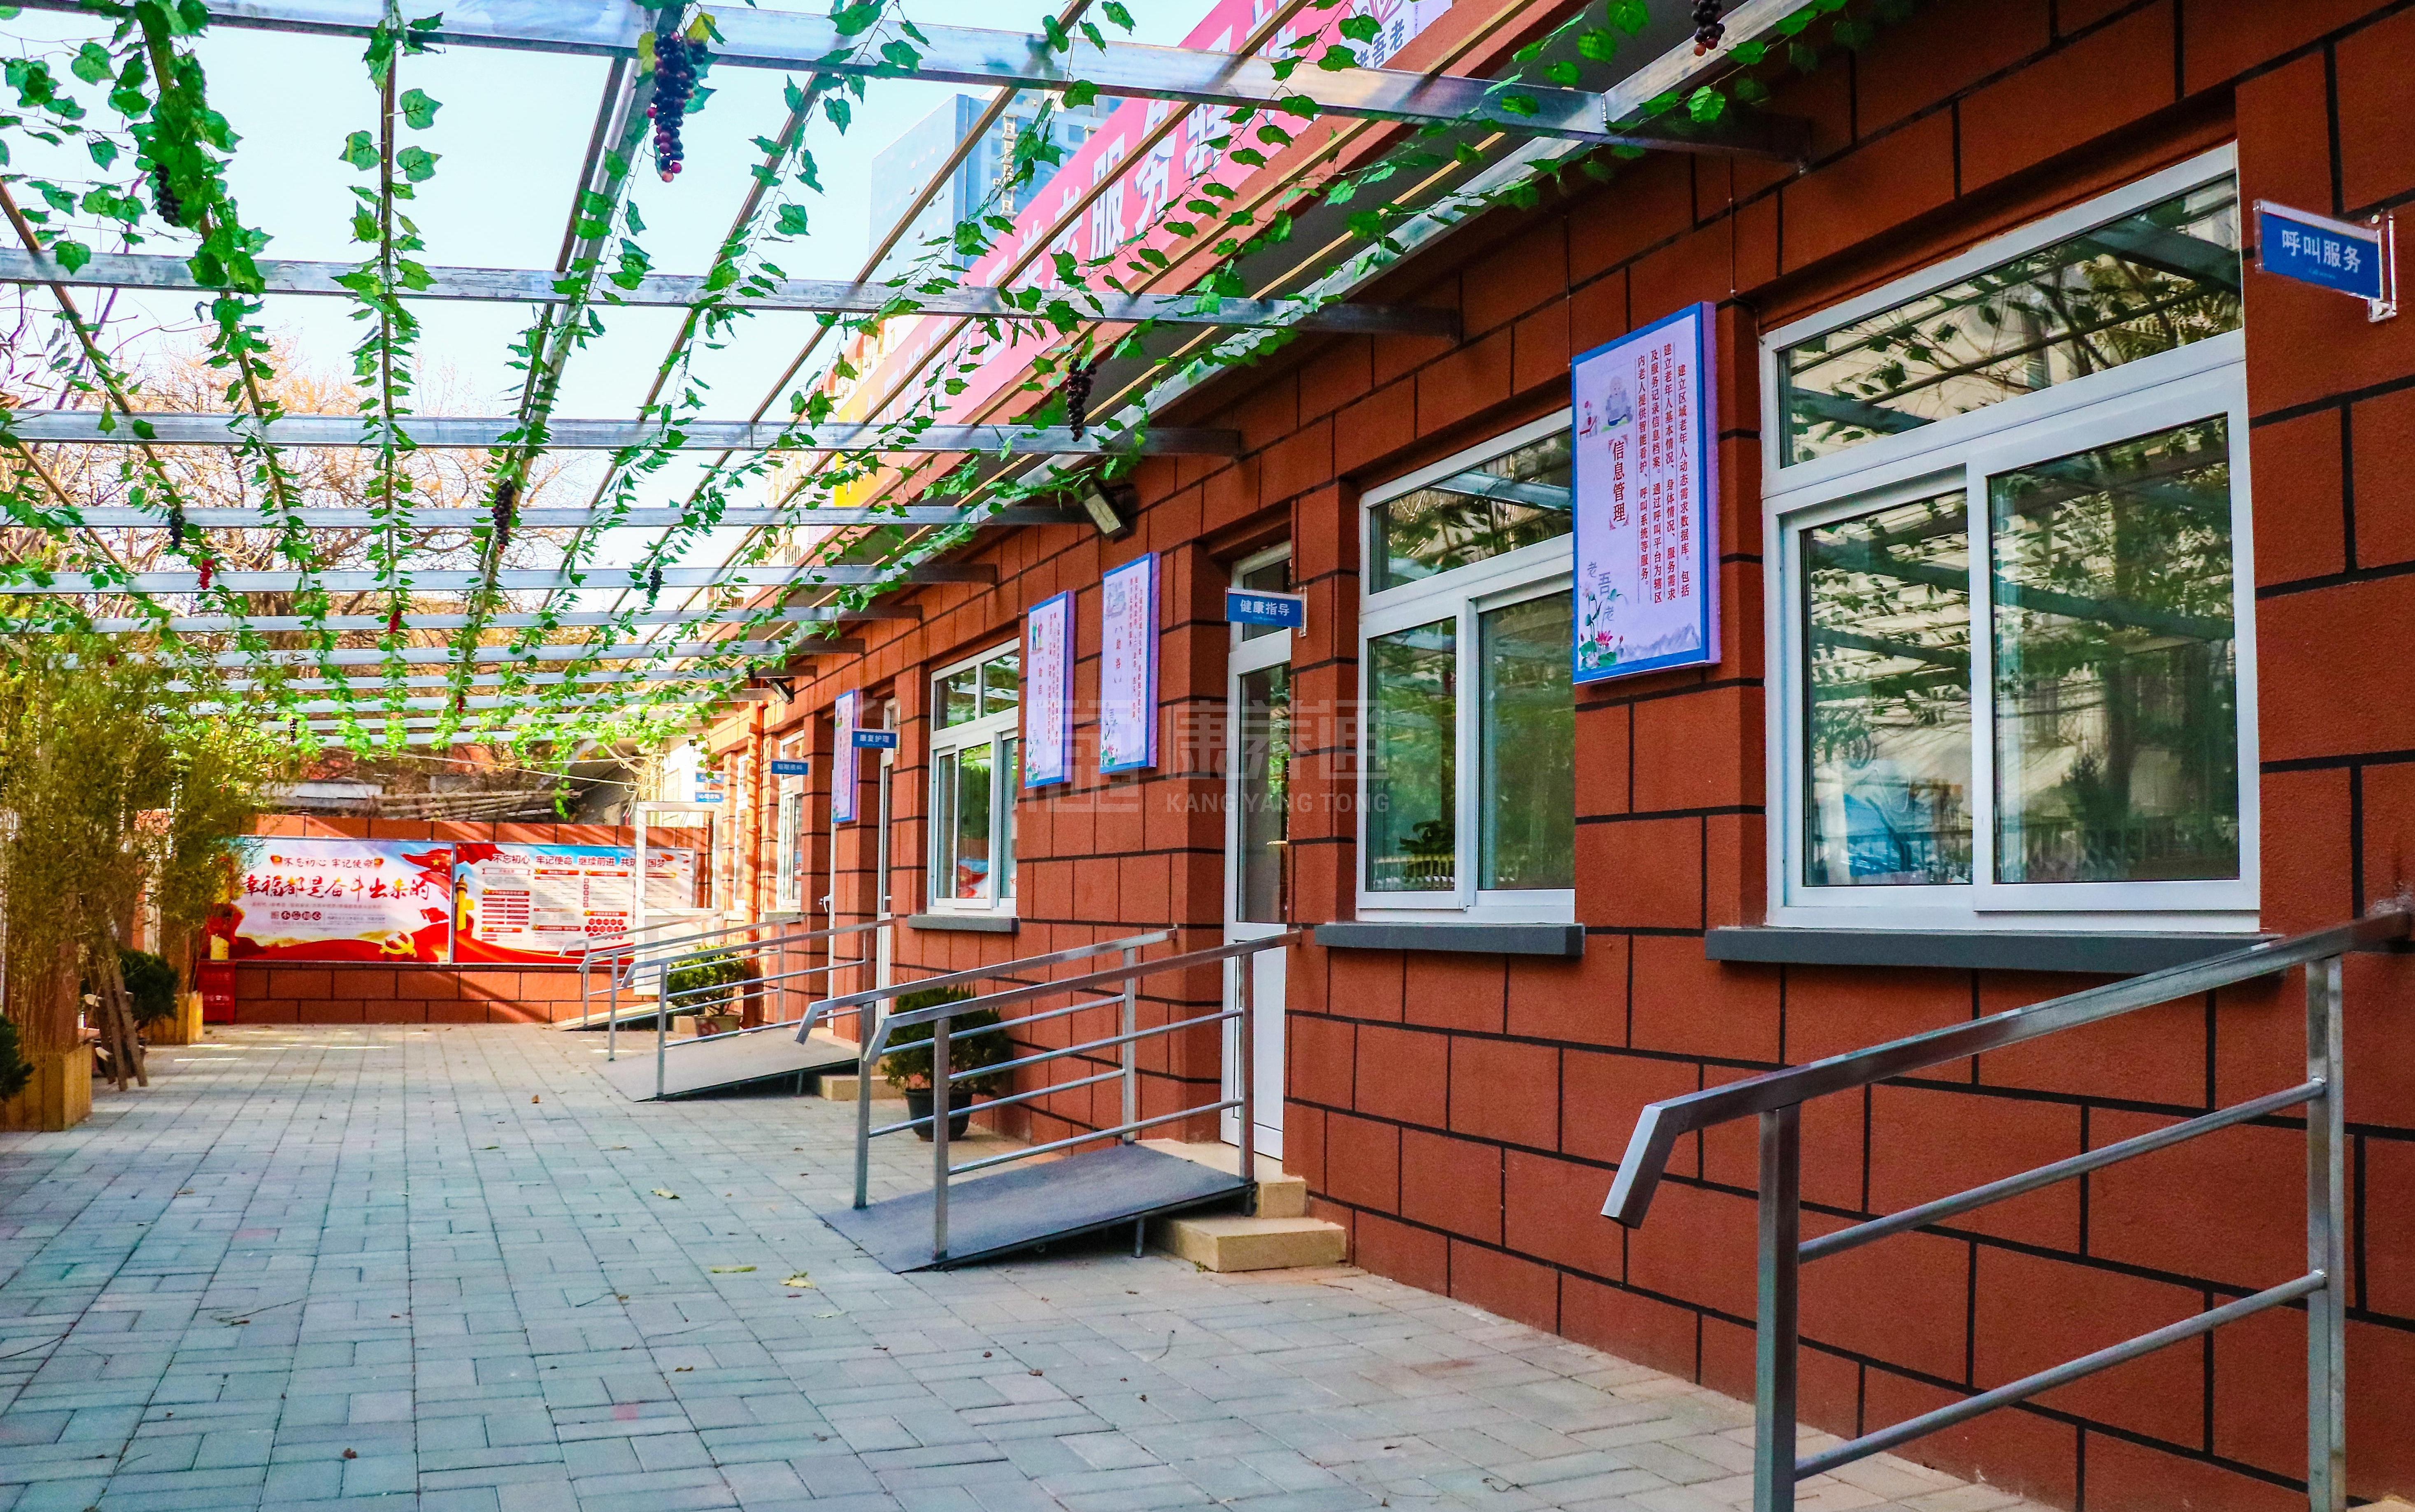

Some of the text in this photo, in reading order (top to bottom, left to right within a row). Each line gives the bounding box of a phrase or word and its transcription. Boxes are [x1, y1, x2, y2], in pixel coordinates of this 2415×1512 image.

[2282, 230, 2361, 273] 呼叫服务
[1612, 440, 1626, 523] 信息管理
[1240, 599, 1290, 616] 健康指导
[859, 734, 890, 743] 康复护理
[284, 857, 374, 869] 不忘初心 牢记使命
[493, 854, 665, 868] 不忘初心 牢记使命 继续前进 共筑国梦
[242, 874, 430, 902] 幸福都是奋斗出来的
